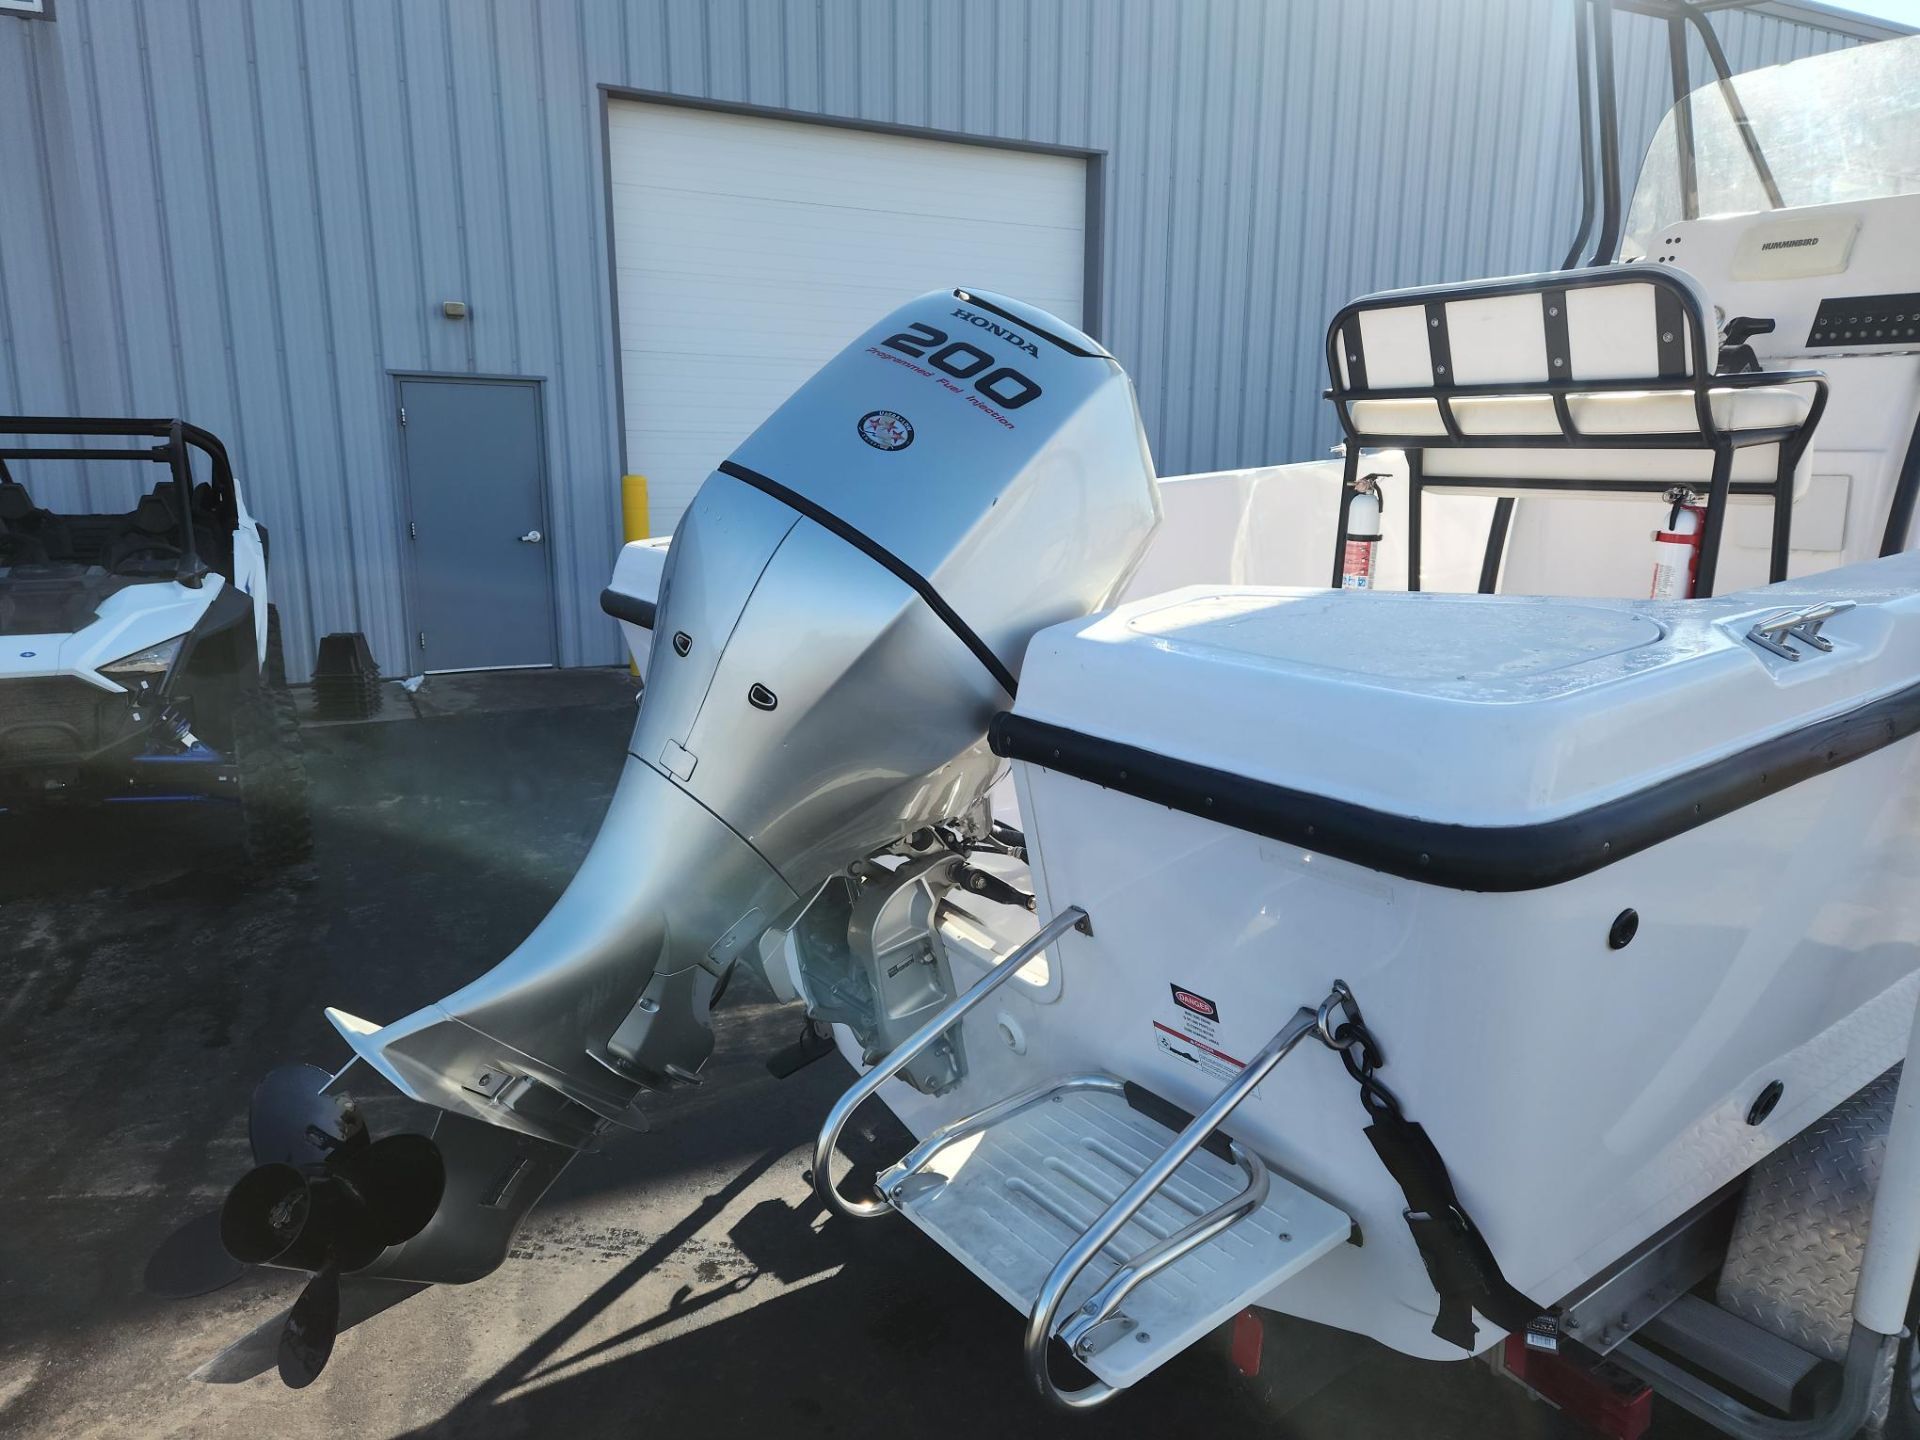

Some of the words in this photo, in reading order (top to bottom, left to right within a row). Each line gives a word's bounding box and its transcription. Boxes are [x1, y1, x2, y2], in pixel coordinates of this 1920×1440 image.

[1762, 238, 1819, 251] HUMMINBIRD
[951, 308, 1039, 359] HONDA
[866, 347, 935, 378] Programmed
[936, 377, 964, 394] Fuel
[965, 395, 1016, 430] Injection
[881, 322, 1042, 410] 200
[1178, 993, 1213, 1013] DANGER
